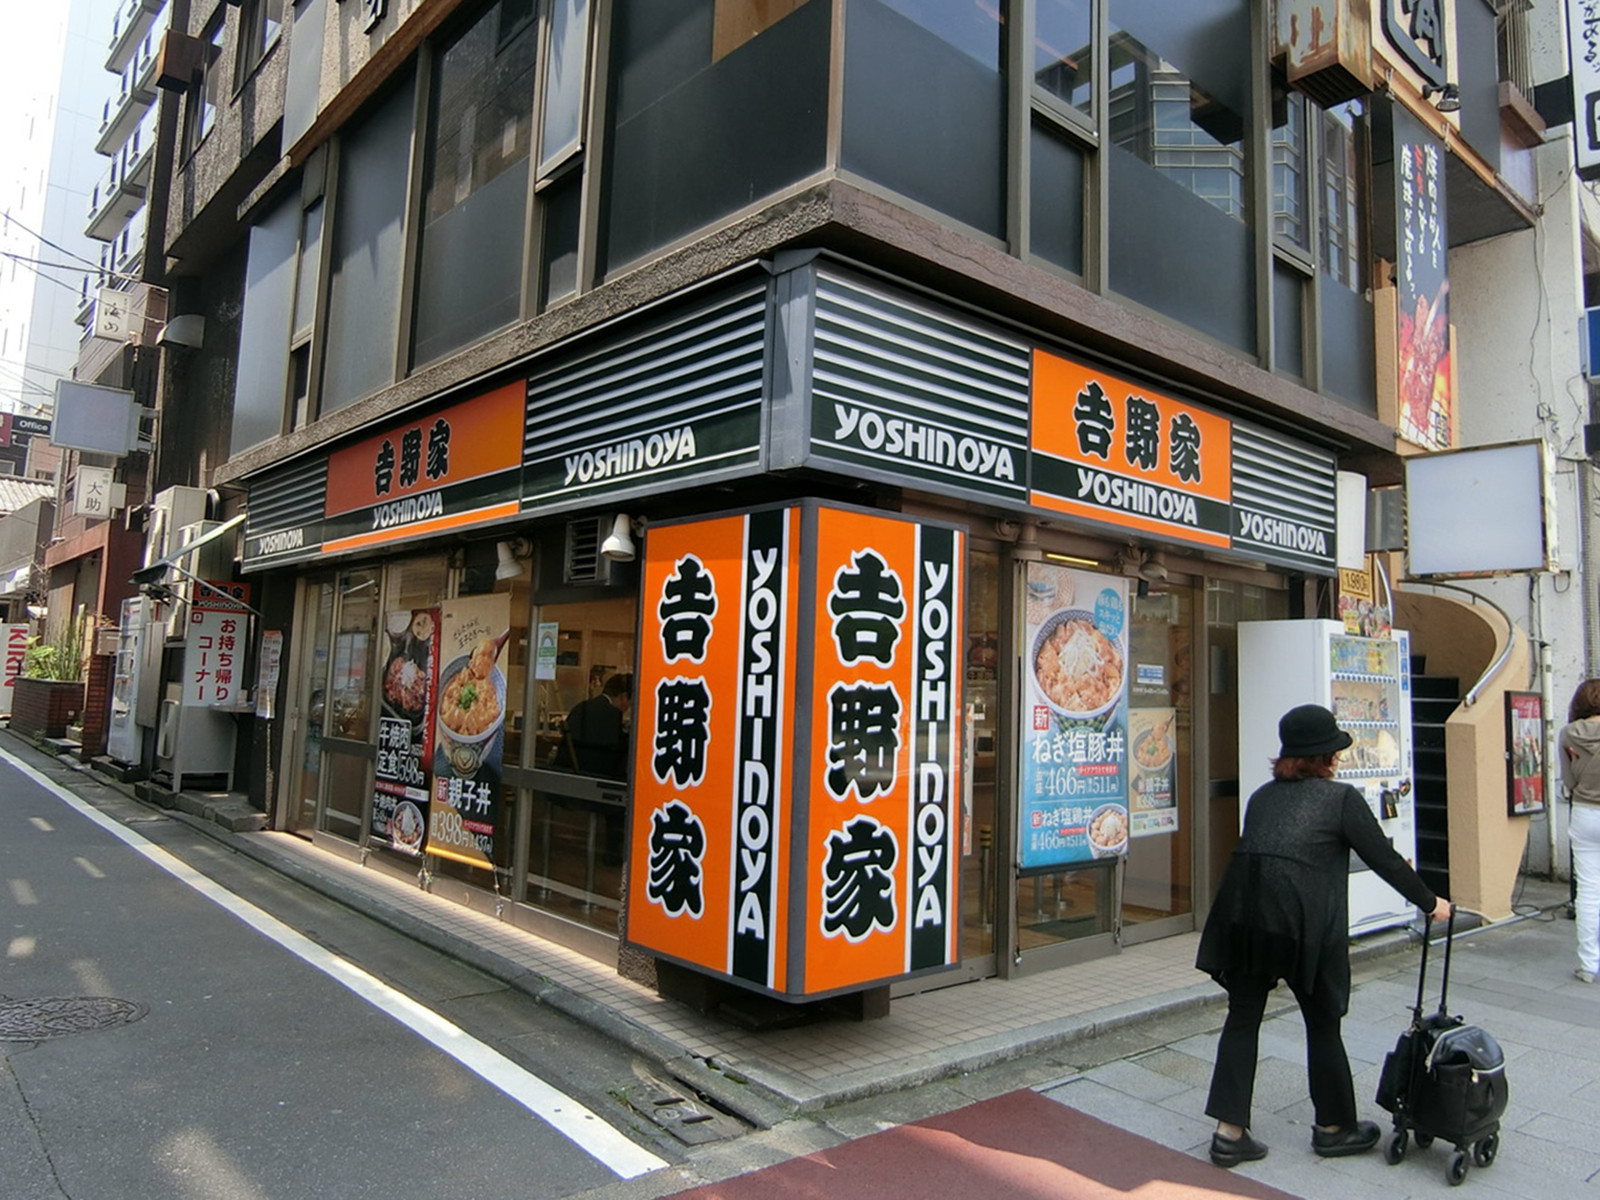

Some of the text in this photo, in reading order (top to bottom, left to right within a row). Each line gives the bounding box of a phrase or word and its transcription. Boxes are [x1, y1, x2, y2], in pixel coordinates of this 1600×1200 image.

[20, 420, 48, 431] Office
[564, 425, 696, 487] YOSHINOYA
[834, 403, 1015, 481] YOSHINOYA
[1073, 379, 1202, 484] 吉野家
[374, 417, 452, 497] 吉野家
[85, 481, 103, 512] 大助
[372, 491, 444, 530] YOSHINOYA
[1077, 467, 1198, 526] YOSHINOYA
[258, 528, 304, 556] YOSHINOYA
[1240, 511, 1327, 556] YOSHINOYA
[195, 636, 213, 701] コーナー
[215, 619, 237, 701] お持ち帰り
[646, 552, 718, 920] 吉野家
[737, 547, 779, 940] YOSHINOYA
[820, 547, 907, 944] 吉野家
[915, 560, 950, 929] YOSHINOYA
[1032, 731, 1124, 763] ねぎ塩豚丼
[1034, 706, 1048, 730] 新
[448, 777, 492, 815] 親子丼
